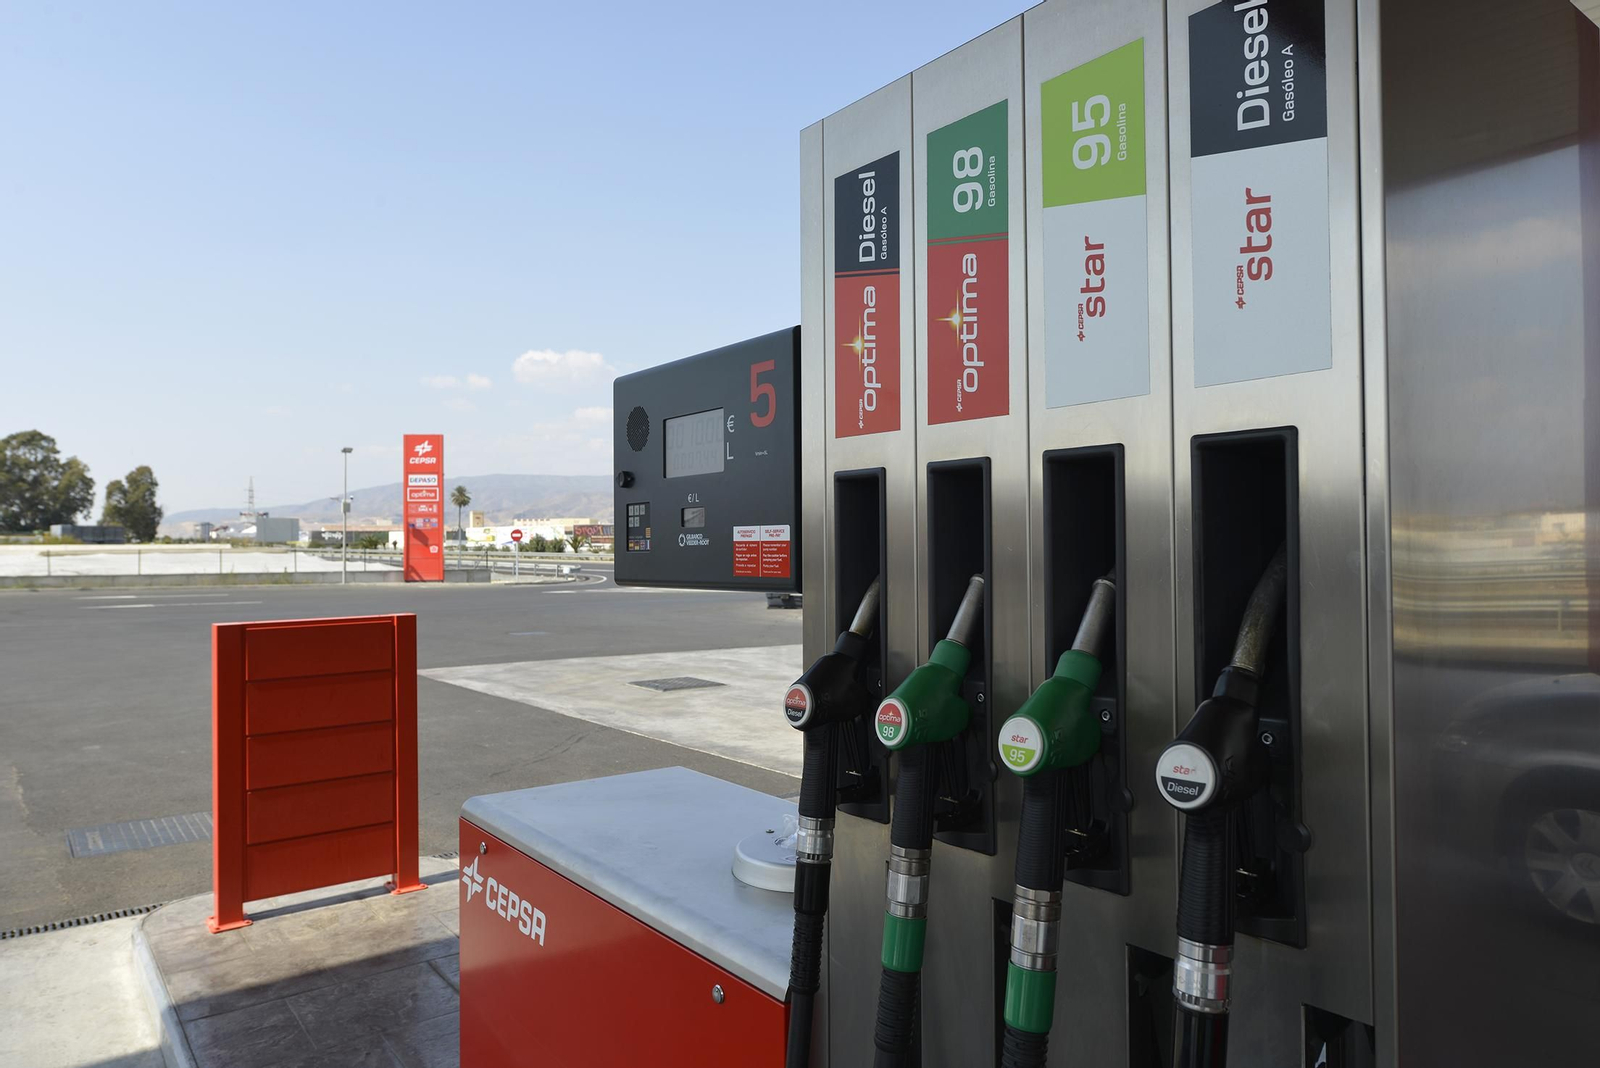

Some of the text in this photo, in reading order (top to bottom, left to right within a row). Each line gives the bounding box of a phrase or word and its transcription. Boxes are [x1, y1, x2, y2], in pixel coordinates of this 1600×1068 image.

[1233, 0, 1270, 131] Diesel
[1281, 44, 1295, 122] Gasóleo A
[1071, 94, 1111, 170] 95
[1116, 103, 1127, 161] Gasolina
[952, 146, 984, 213] 98
[987, 155, 996, 207] Gasolina
[858, 171, 876, 263] Diesel
[880, 206, 888, 260] Gasóleo A
[1240, 187, 1273, 281] star
[1080, 235, 1106, 318] star
[1236, 265, 1245, 296] CEPSA
[960, 253, 985, 393] optima
[1077, 303, 1085, 330] CEPSA
[861, 285, 882, 412] optima
[750, 359, 776, 428] 5
[726, 414, 735, 433] €
[726, 442, 734, 460] L
[787, 708, 803, 718] Diesel
[879, 714, 901, 722] optima
[882, 726, 895, 738] 98
[1011, 734, 1029, 744] star
[1009, 748, 1026, 763] 95
[1167, 781, 1200, 796] Diesel
[485, 876, 547, 947] CEPSA
